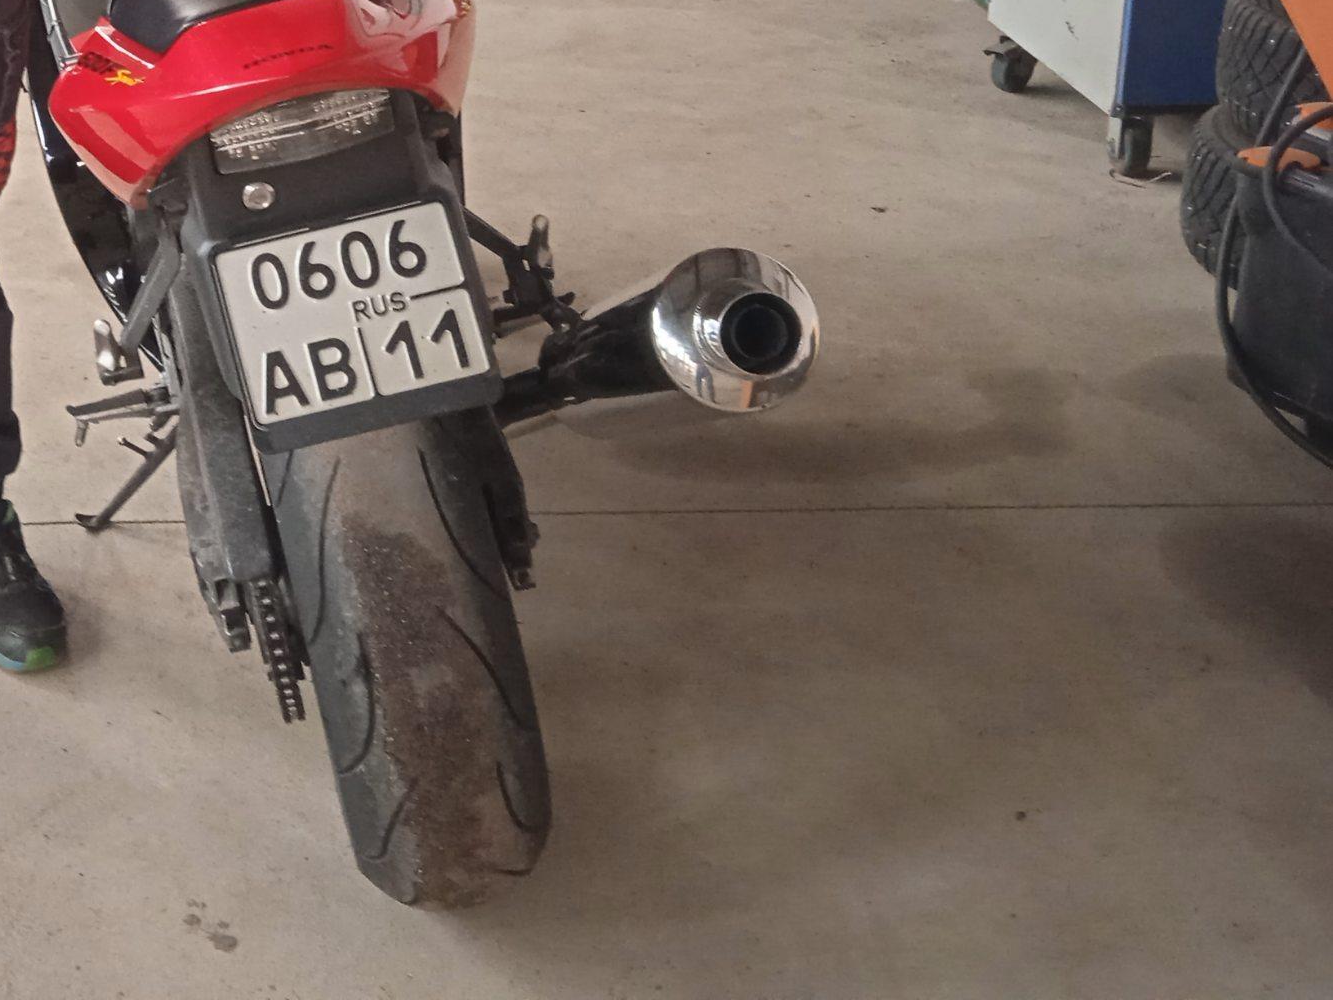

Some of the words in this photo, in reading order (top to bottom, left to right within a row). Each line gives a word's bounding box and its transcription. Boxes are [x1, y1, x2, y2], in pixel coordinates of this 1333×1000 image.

[251, 219, 427, 310] 0606
[353, 291, 407, 321] RUS
[265, 337, 357, 415] AB
[385, 308, 470, 379] 11
